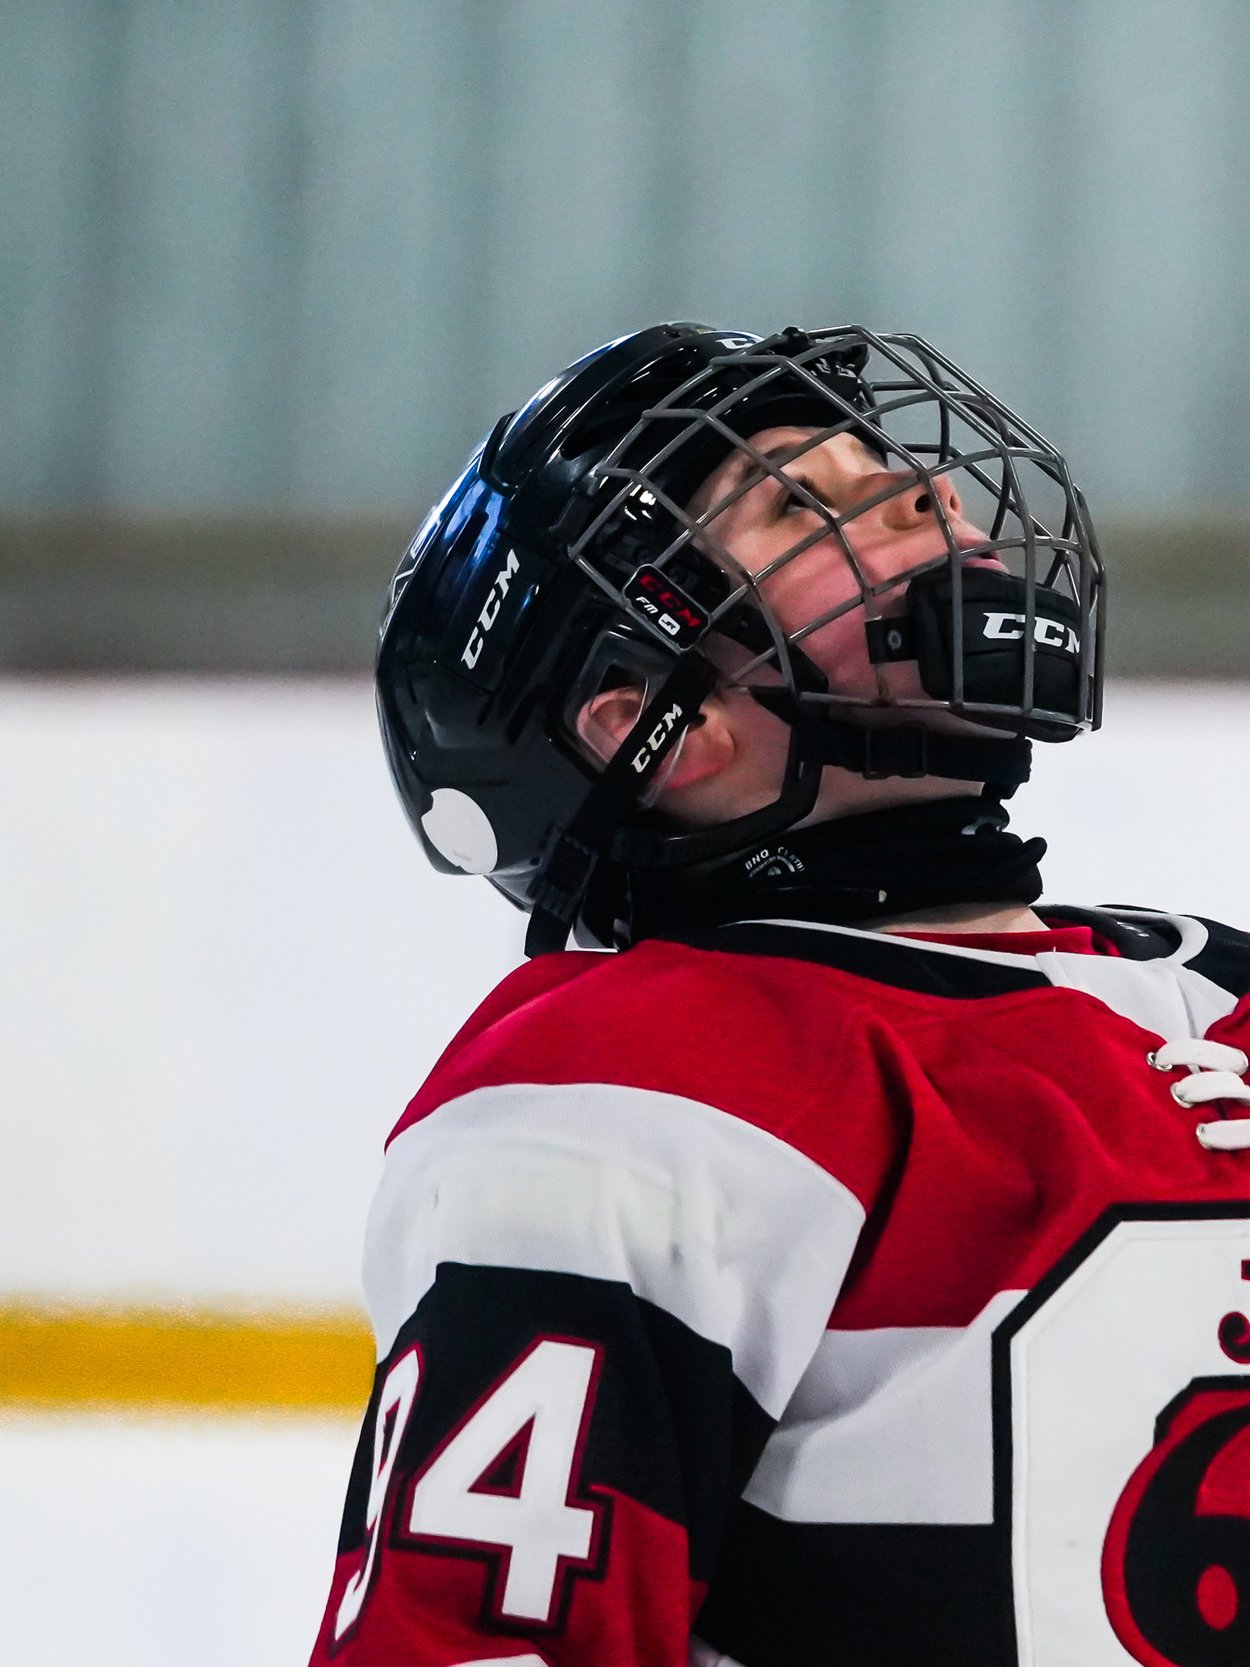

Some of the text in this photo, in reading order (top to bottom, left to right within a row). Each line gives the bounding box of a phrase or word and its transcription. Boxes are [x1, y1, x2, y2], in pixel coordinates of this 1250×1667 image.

[460, 548, 520, 670] CCM
[640, 575, 702, 628] CCM
[631, 703, 683, 773] CCM
[333, 1334, 605, 1626] 94
